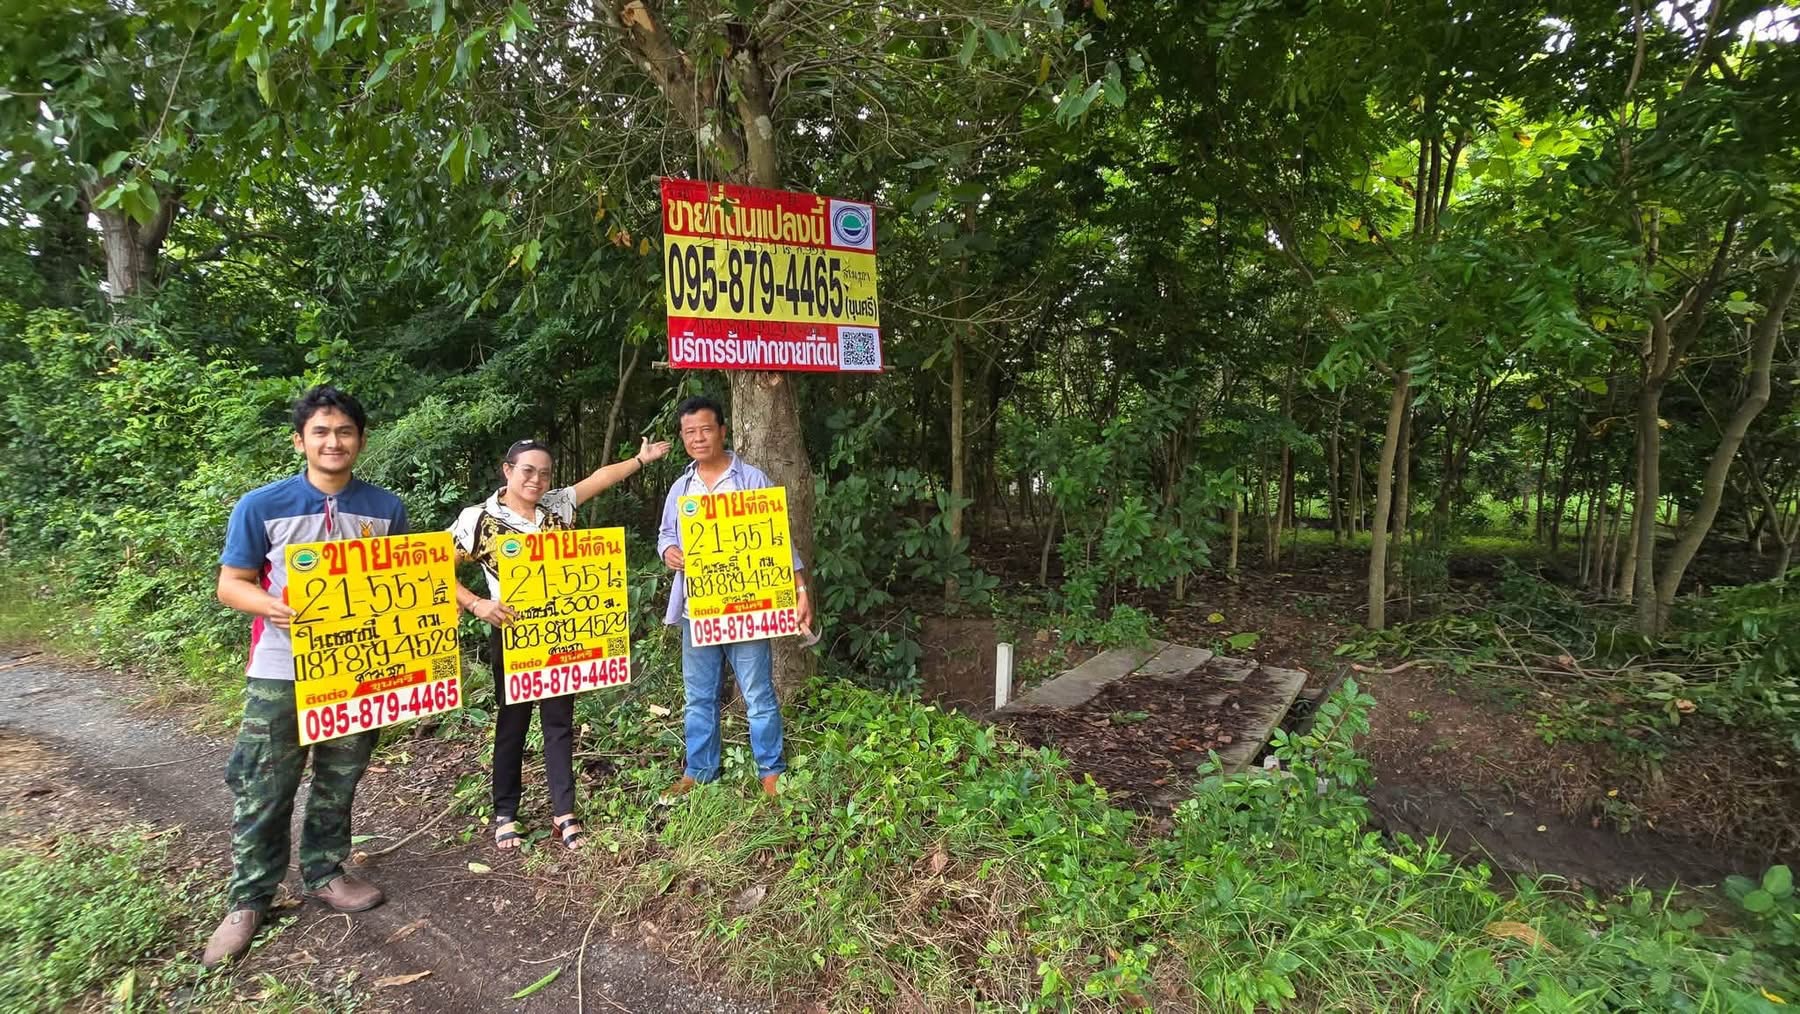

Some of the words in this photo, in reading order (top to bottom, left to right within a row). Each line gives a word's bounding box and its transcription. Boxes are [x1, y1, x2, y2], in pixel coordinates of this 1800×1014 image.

[667, 184, 826, 245] ขายที่ดินแปลงนี้
[668, 242, 843, 318] 095-879-4465
[846, 296, 878, 321] (ขุนศรี)
[671, 327, 838, 366] บริการรับฝากขายที่ดิน
[746, 555, 751, 569] 1
[561, 594, 600, 616] 300
[393, 614, 403, 635] 1
[694, 608, 796, 645] 095-879-4465
[509, 656, 628, 702] 095-879-4465
[306, 679, 458, 741] 095-879-4465
